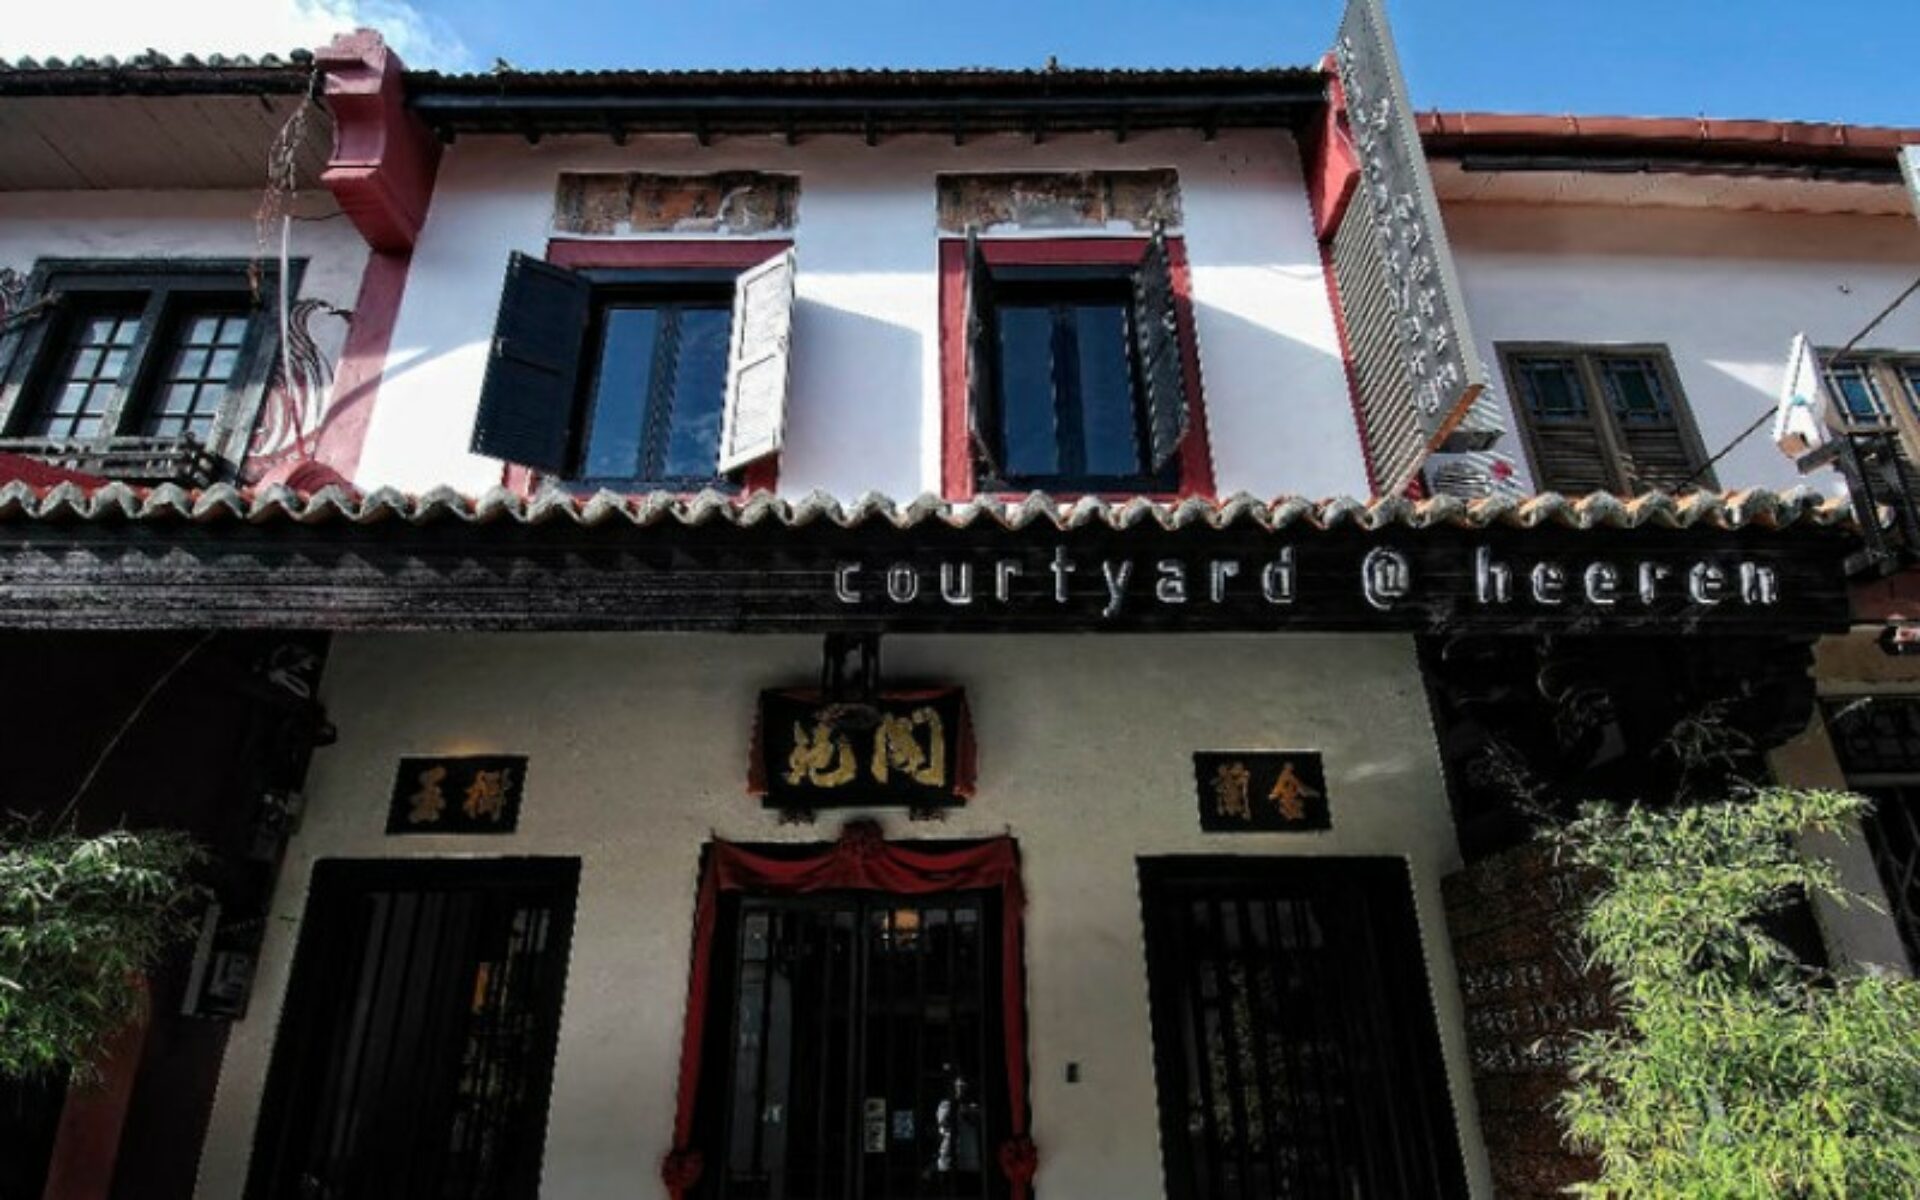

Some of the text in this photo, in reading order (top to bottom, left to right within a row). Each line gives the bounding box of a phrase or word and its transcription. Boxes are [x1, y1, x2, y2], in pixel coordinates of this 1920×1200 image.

[834, 545, 1778, 617] courtyard @ heeren
